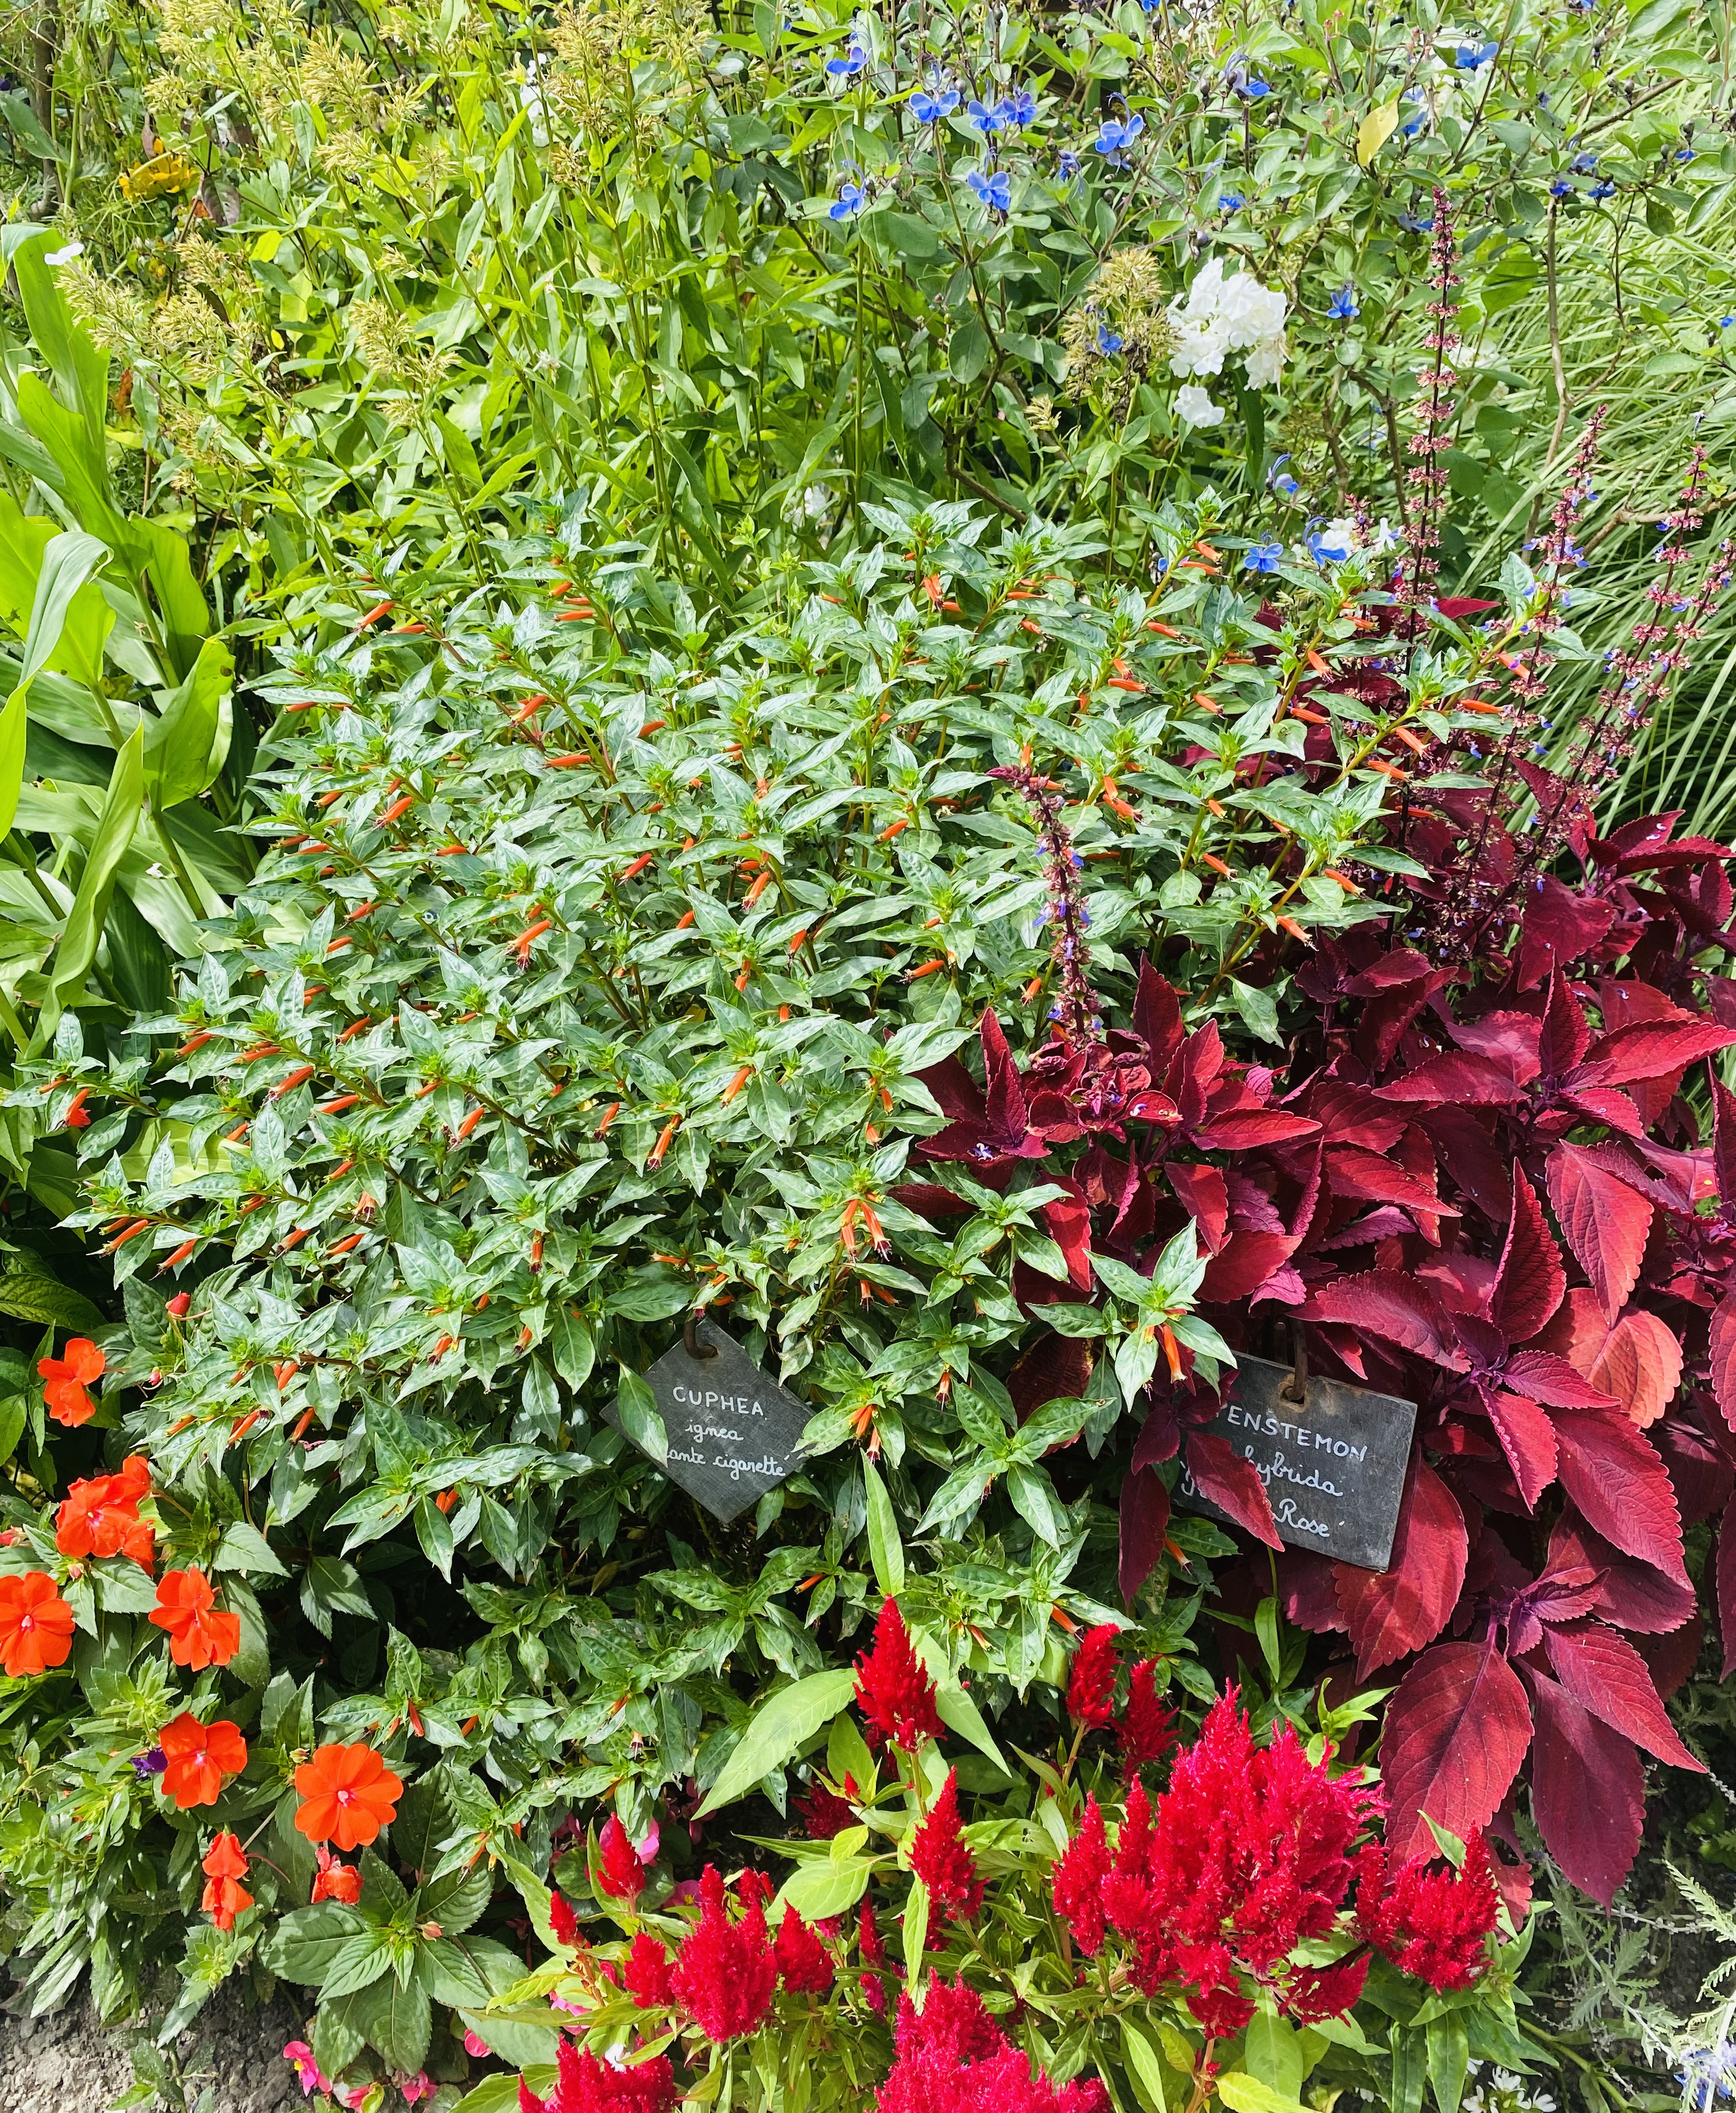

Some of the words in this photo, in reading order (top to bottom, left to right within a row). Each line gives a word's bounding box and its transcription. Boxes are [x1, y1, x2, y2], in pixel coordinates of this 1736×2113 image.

[685, 1419, 744, 1444] ignea
[1215, 1404, 1367, 1462] ENSTEMON
[666, 1446, 706, 1465] ante
